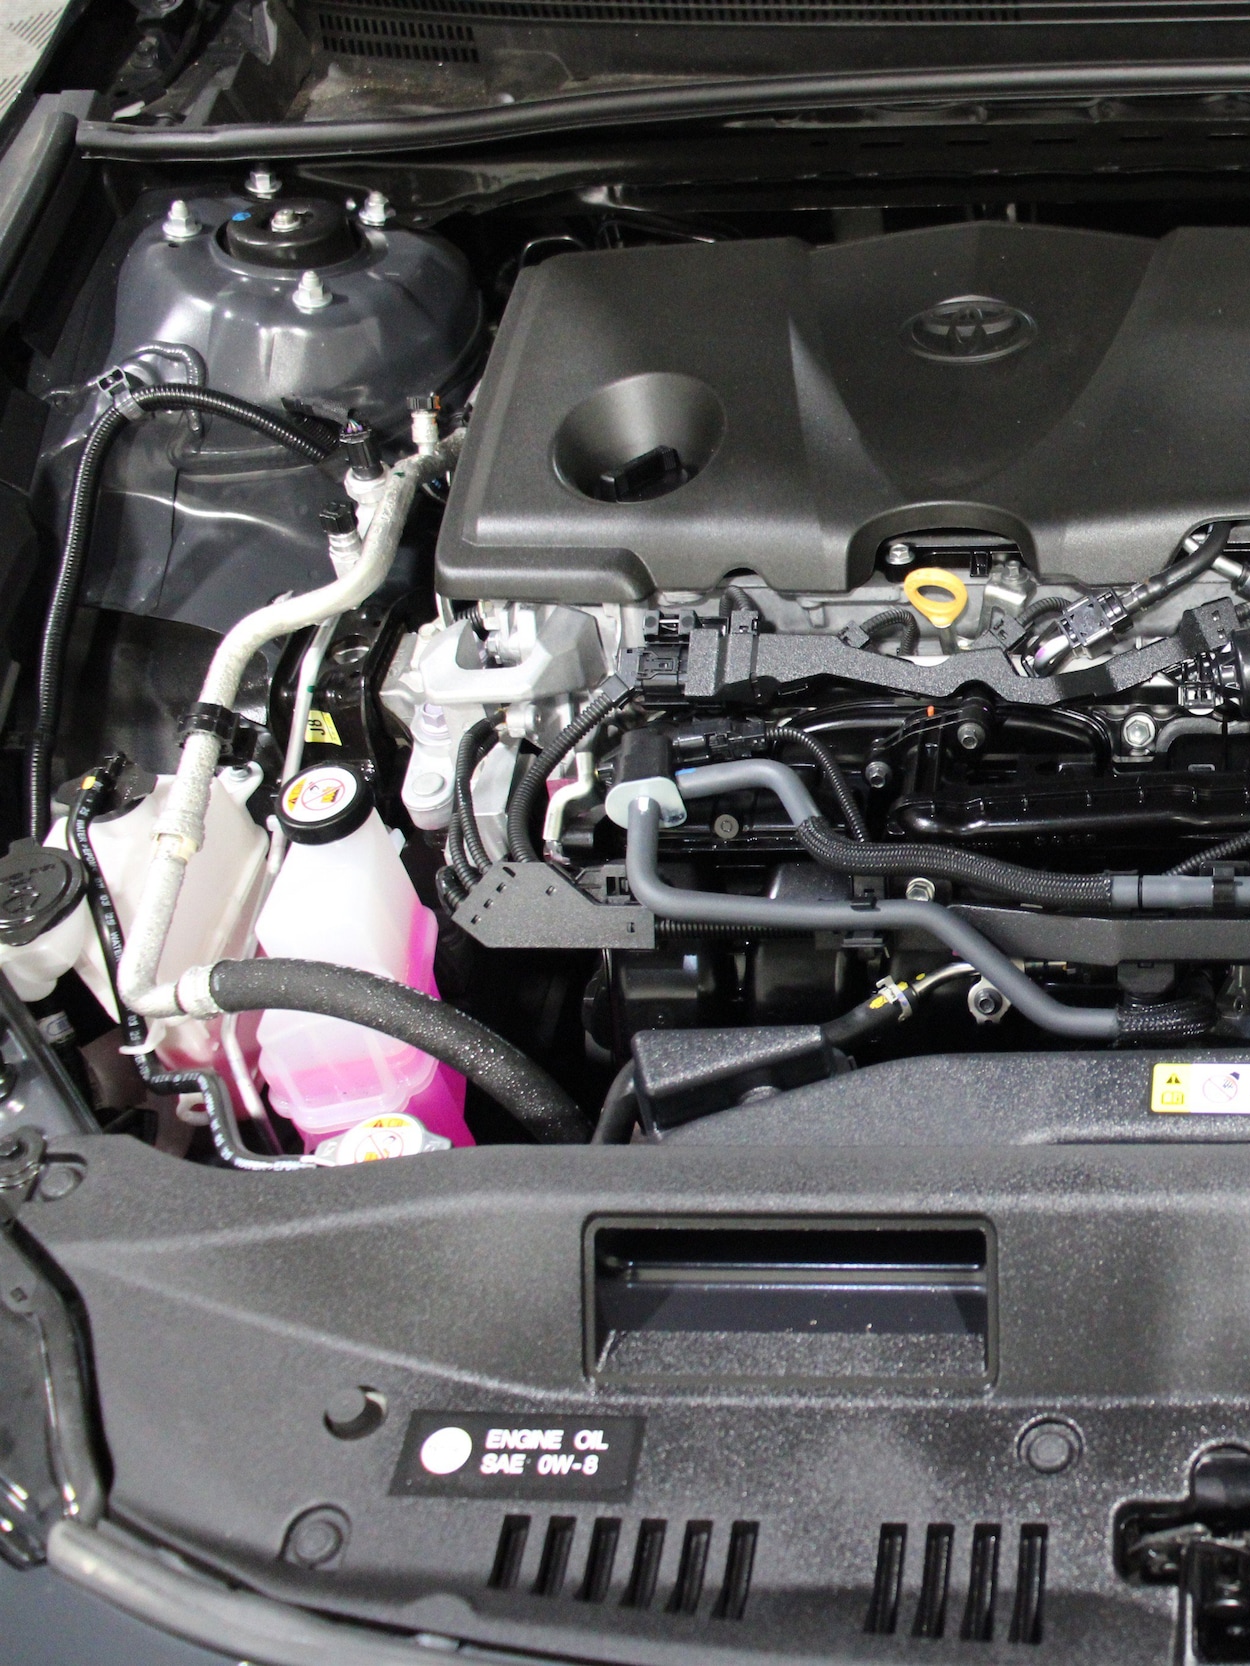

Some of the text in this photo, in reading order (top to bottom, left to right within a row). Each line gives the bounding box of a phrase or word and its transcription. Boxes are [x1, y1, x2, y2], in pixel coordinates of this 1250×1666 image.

[486, 1429, 608, 1450] ENGINE OIL
[480, 1453, 598, 1475] SAE 0W-8
